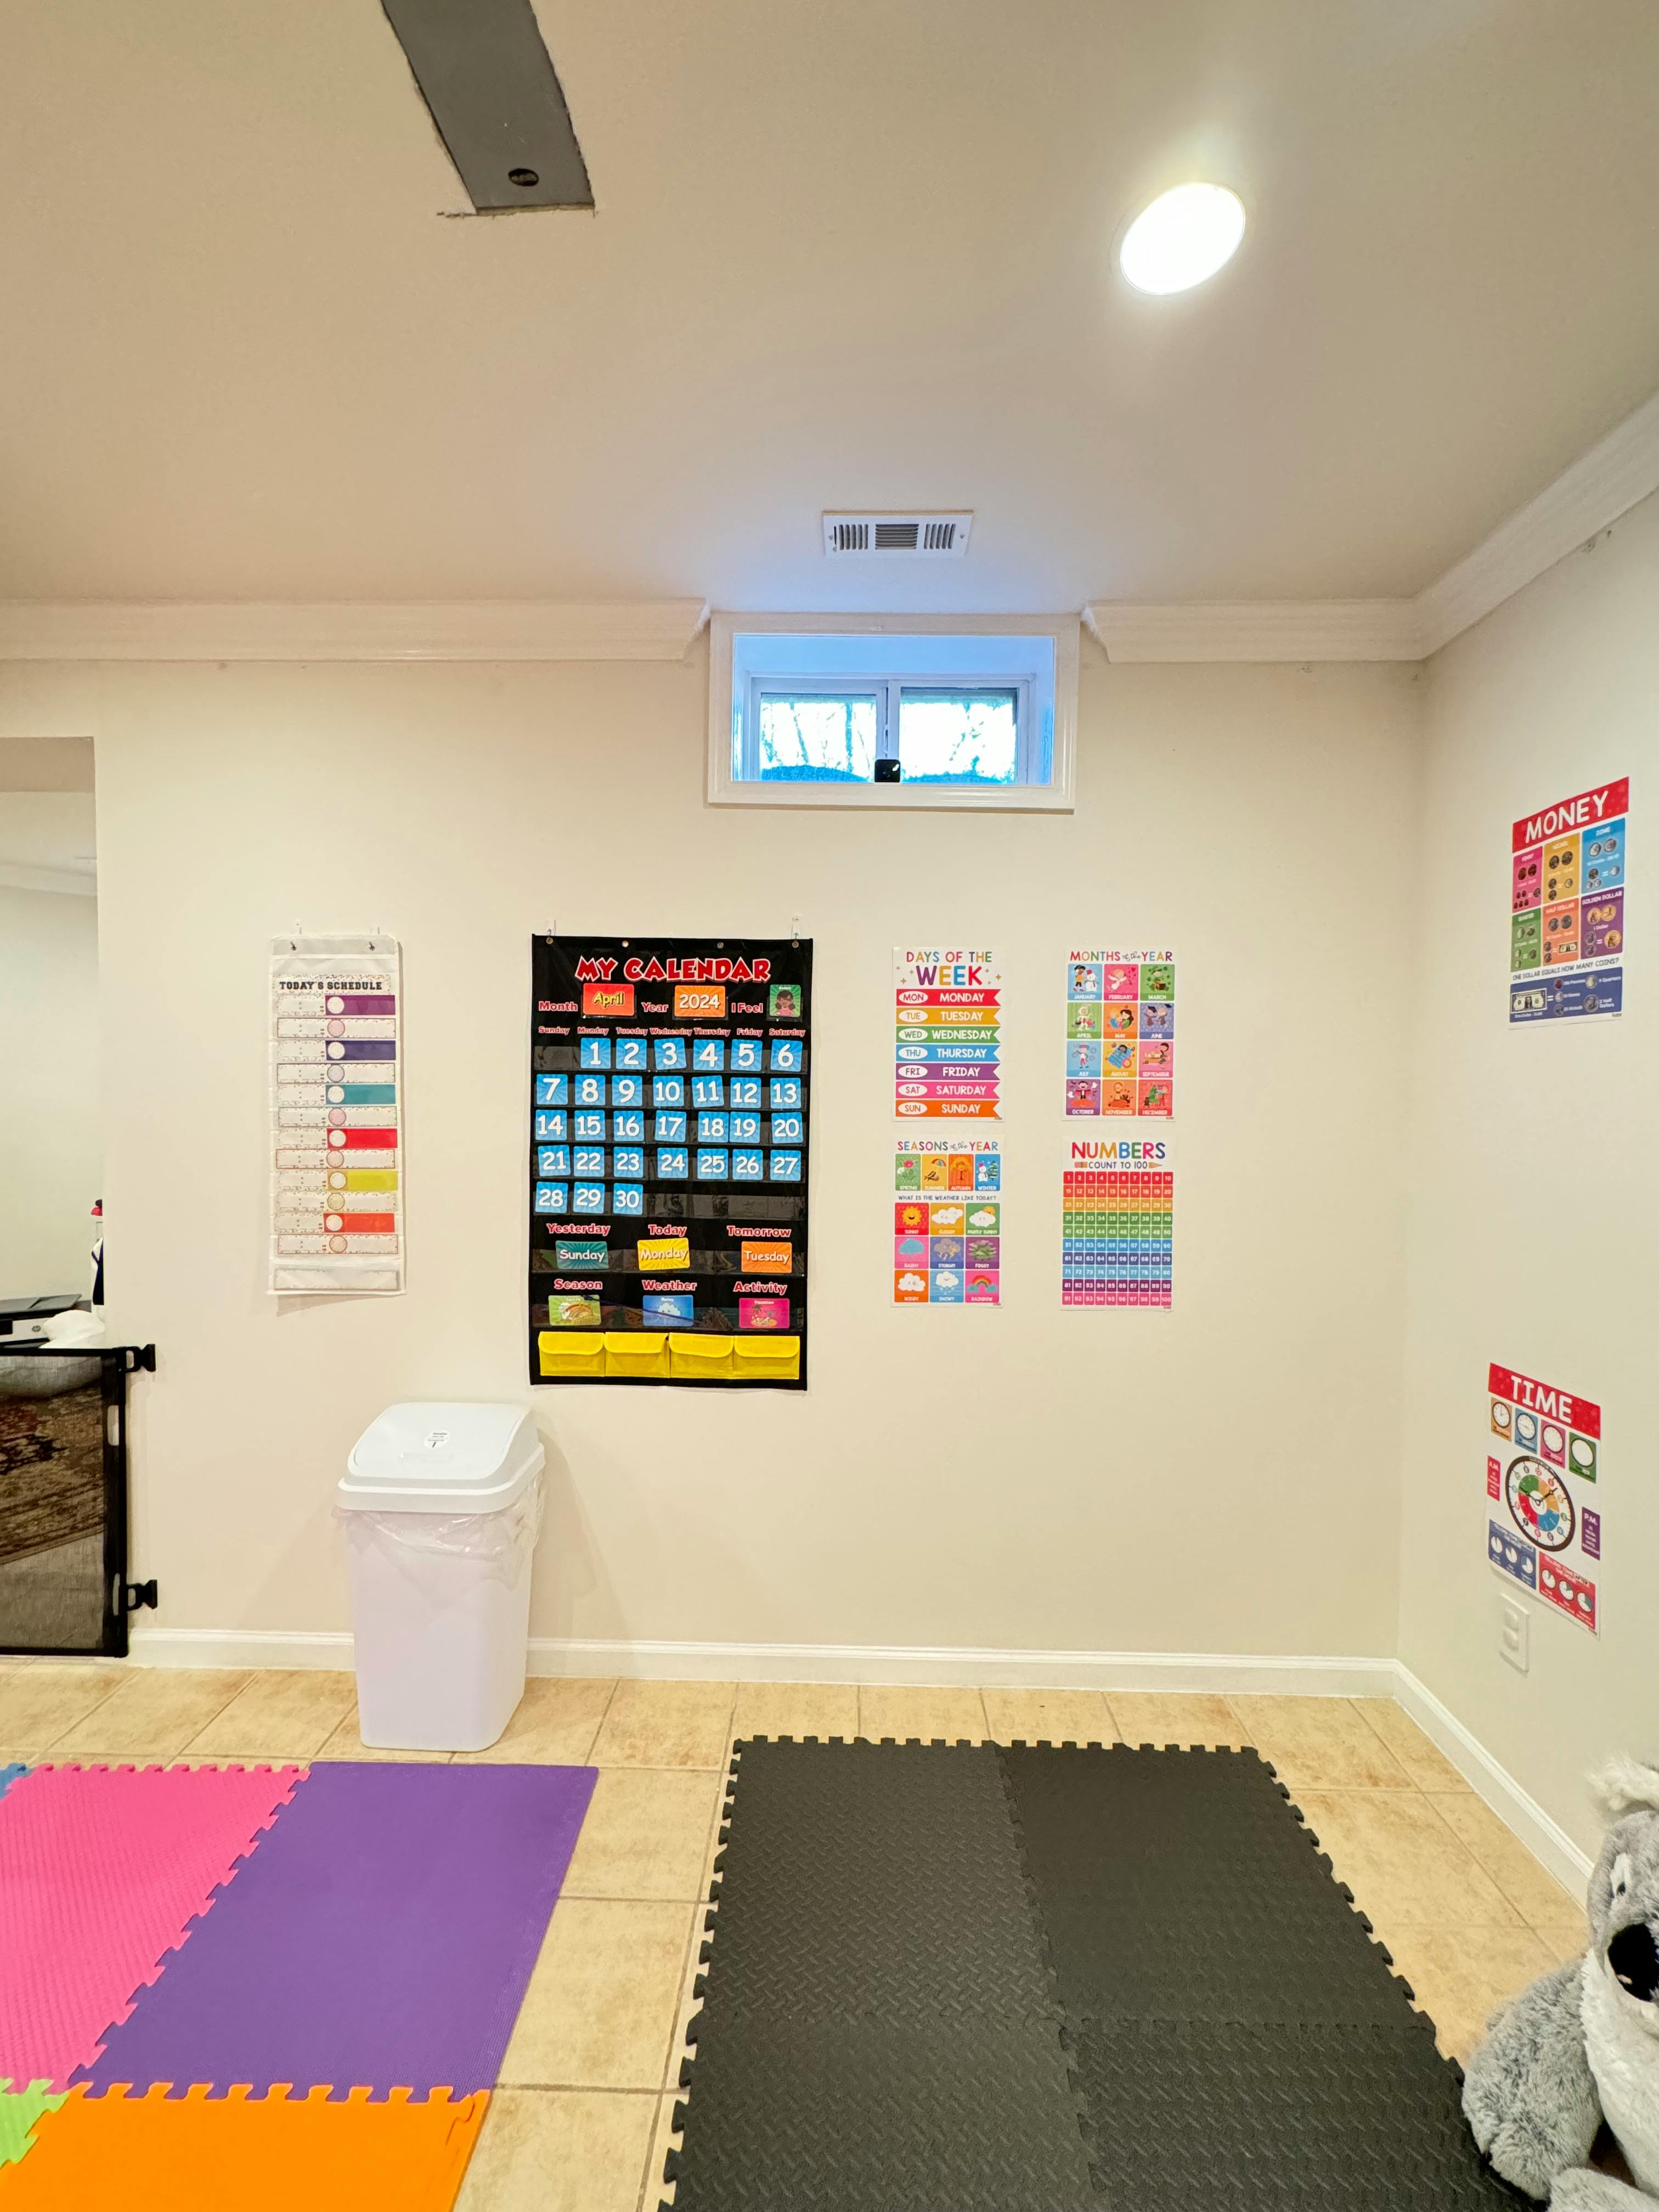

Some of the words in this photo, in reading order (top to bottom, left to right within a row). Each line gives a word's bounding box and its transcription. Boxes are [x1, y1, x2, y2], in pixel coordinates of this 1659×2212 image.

[1526, 791, 1609, 843] MONEY
[1602, 891, 1622, 900] DOLLAR
[906, 952, 939, 962] DAYS
[945, 952, 963, 962] OF
[969, 952, 992, 962] THE
[1070, 951, 1120, 961] MONTHS
[1122, 952, 1130, 962] of
[1142, 951, 1172, 961] YEAR
[575, 955, 618, 982] MY
[624, 956, 771, 983] CALENDAR
[1541, 968, 1560, 976] EQUALS
[1595, 958, 1619, 966] COINS?
[916, 966, 983, 986] WEEK
[279, 981, 324, 990] TODAY'S
[327, 981, 382, 990] SCHEDULE
[539, 1001, 578, 1012] Month
[641, 1002, 668, 1012] Year
[679, 994, 720, 1009] 2024
[731, 1002, 736, 1013] I
[738, 1002, 763, 1013] Feel
[593, 992, 625, 1008] April
[939, 993, 984, 1002] MONDAY
[940, 1011, 983, 1021] TUESDAY
[538, 1026, 570, 1035] Sunday
[578, 1026, 609, 1035] Monday
[616, 1027, 648, 1035] Tuesday
[650, 1027, 692, 1036] Wednesday
[693, 1028, 730, 1036] Thursday
[737, 1028, 763, 1036] Friday
[769, 1028, 806, 1037] Saturday
[932, 1030, 992, 1040] WEDNESDAY
[590, 1042, 601, 1065] 1
[624, 1042, 639, 1065] 2
[662, 1042, 678, 1065] 3
[699, 1043, 718, 1066] 4
[738, 1043, 754, 1066] 5
[778, 1044, 794, 1066] 6
[936, 1048, 987, 1058] THURSDAY
[943, 1066, 980, 1076] FRIDAY
[543, 1078, 561, 1101] 7
[582, 1079, 599, 1102] 8
[618, 1080, 635, 1103] 9
[656, 1082, 680, 1101] 10
[696, 1080, 719, 1102] 11
[733, 1082, 757, 1103] 12
[774, 1084, 796, 1103] 13
[936, 1085, 986, 1095] SATURDAY
[941, 1104, 980, 1114] SUNDAY
[538, 1114, 563, 1135] 14
[578, 1116, 601, 1135] 15
[616, 1116, 640, 1136] 16
[658, 1116, 682, 1136] 17
[702, 1118, 724, 1137] 18
[733, 1118, 756, 1137] 19
[774, 1119, 799, 1137] 20
[898, 1141, 948, 1151] SEASONS
[950, 1142, 957, 1151] of
[969, 1141, 998, 1151] YEAR
[1071, 1142, 1166, 1159] NUMBERS
[542, 1151, 567, 1170] 21
[576, 1152, 601, 1170] 22
[617, 1153, 639, 1171] 23
[661, 1154, 685, 1172] 24
[701, 1155, 725, 1173] 25
[736, 1156, 759, 1174] 26
[774, 1156, 798, 1174] 27
[539, 1189, 563, 1206] 28
[577, 1189, 601, 1206] 29
[616, 1190, 639, 1207] 30
[546, 1223, 610, 1237] Yesterday
[648, 1224, 687, 1237] Today
[727, 1226, 791, 1237] Tomorrow
[560, 1249, 605, 1262] Sunday
[640, 1247, 688, 1260] Monday
[743, 1250, 791, 1263] Tuesday
[554, 1279, 603, 1290] Season
[641, 1280, 697, 1291] Weather
[733, 1281, 787, 1295] Activity
[1511, 1375, 1572, 1424] TIME
